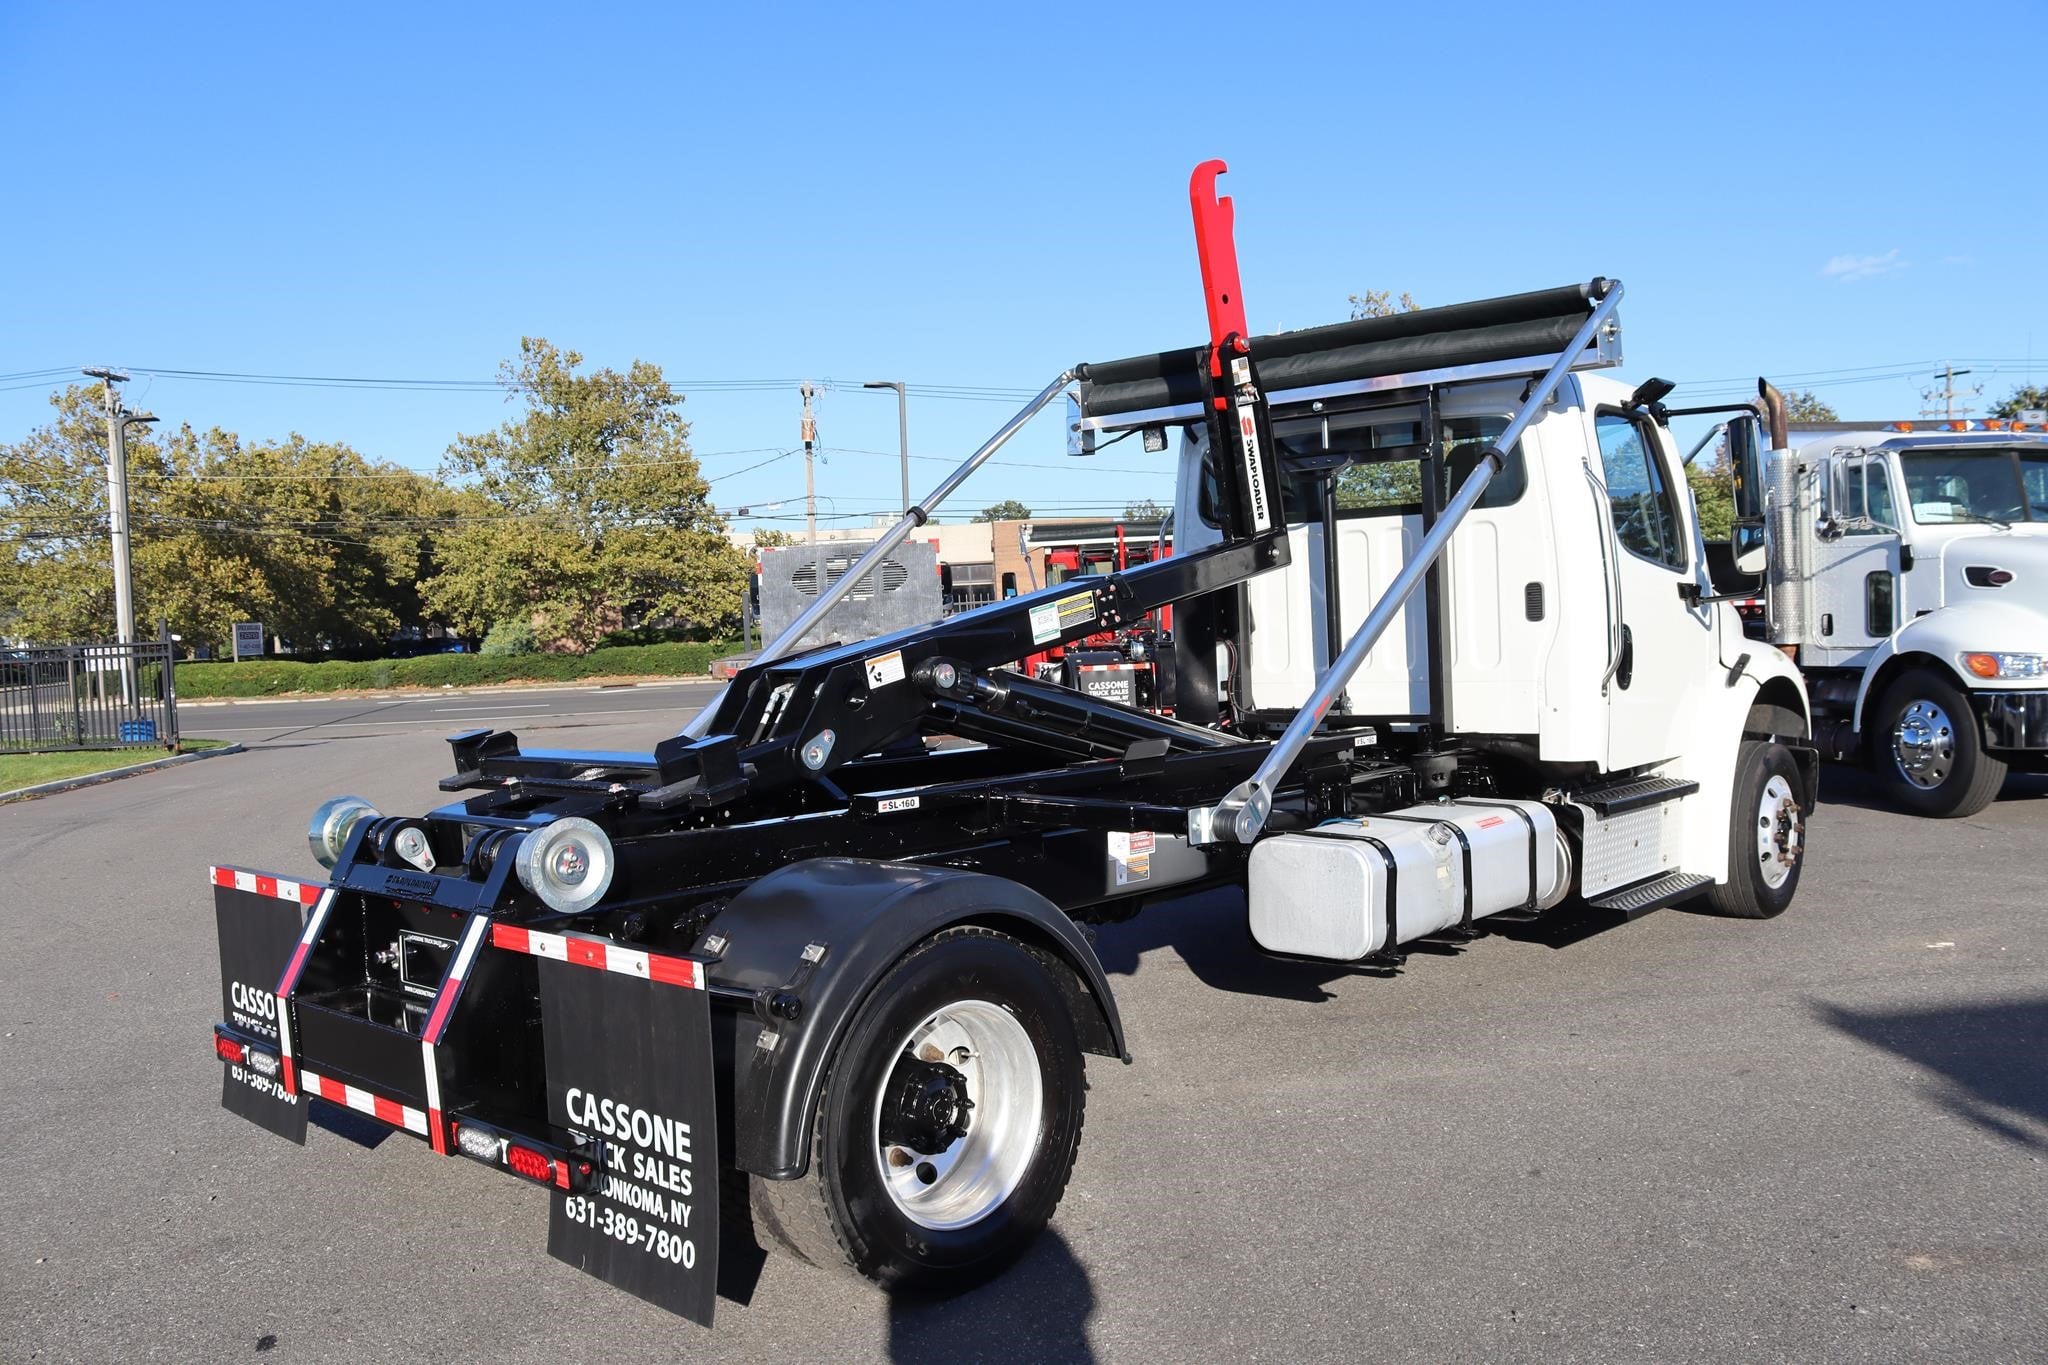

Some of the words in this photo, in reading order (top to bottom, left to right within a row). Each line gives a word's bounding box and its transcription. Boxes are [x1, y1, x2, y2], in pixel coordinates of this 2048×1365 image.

[1246, 439, 1264, 521] SWAPLOADER
[1088, 681, 1129, 690] CASSONE
[888, 799, 916, 809] SL-160
[231, 981, 276, 1021] CASSO
[566, 1088, 692, 1164] CASSONE
[633, 1153, 693, 1196] SALES
[601, 1175, 669, 1223] ONKOMA,
[671, 1199, 692, 1228] NY
[565, 1196, 696, 1270] 631-389-7800
